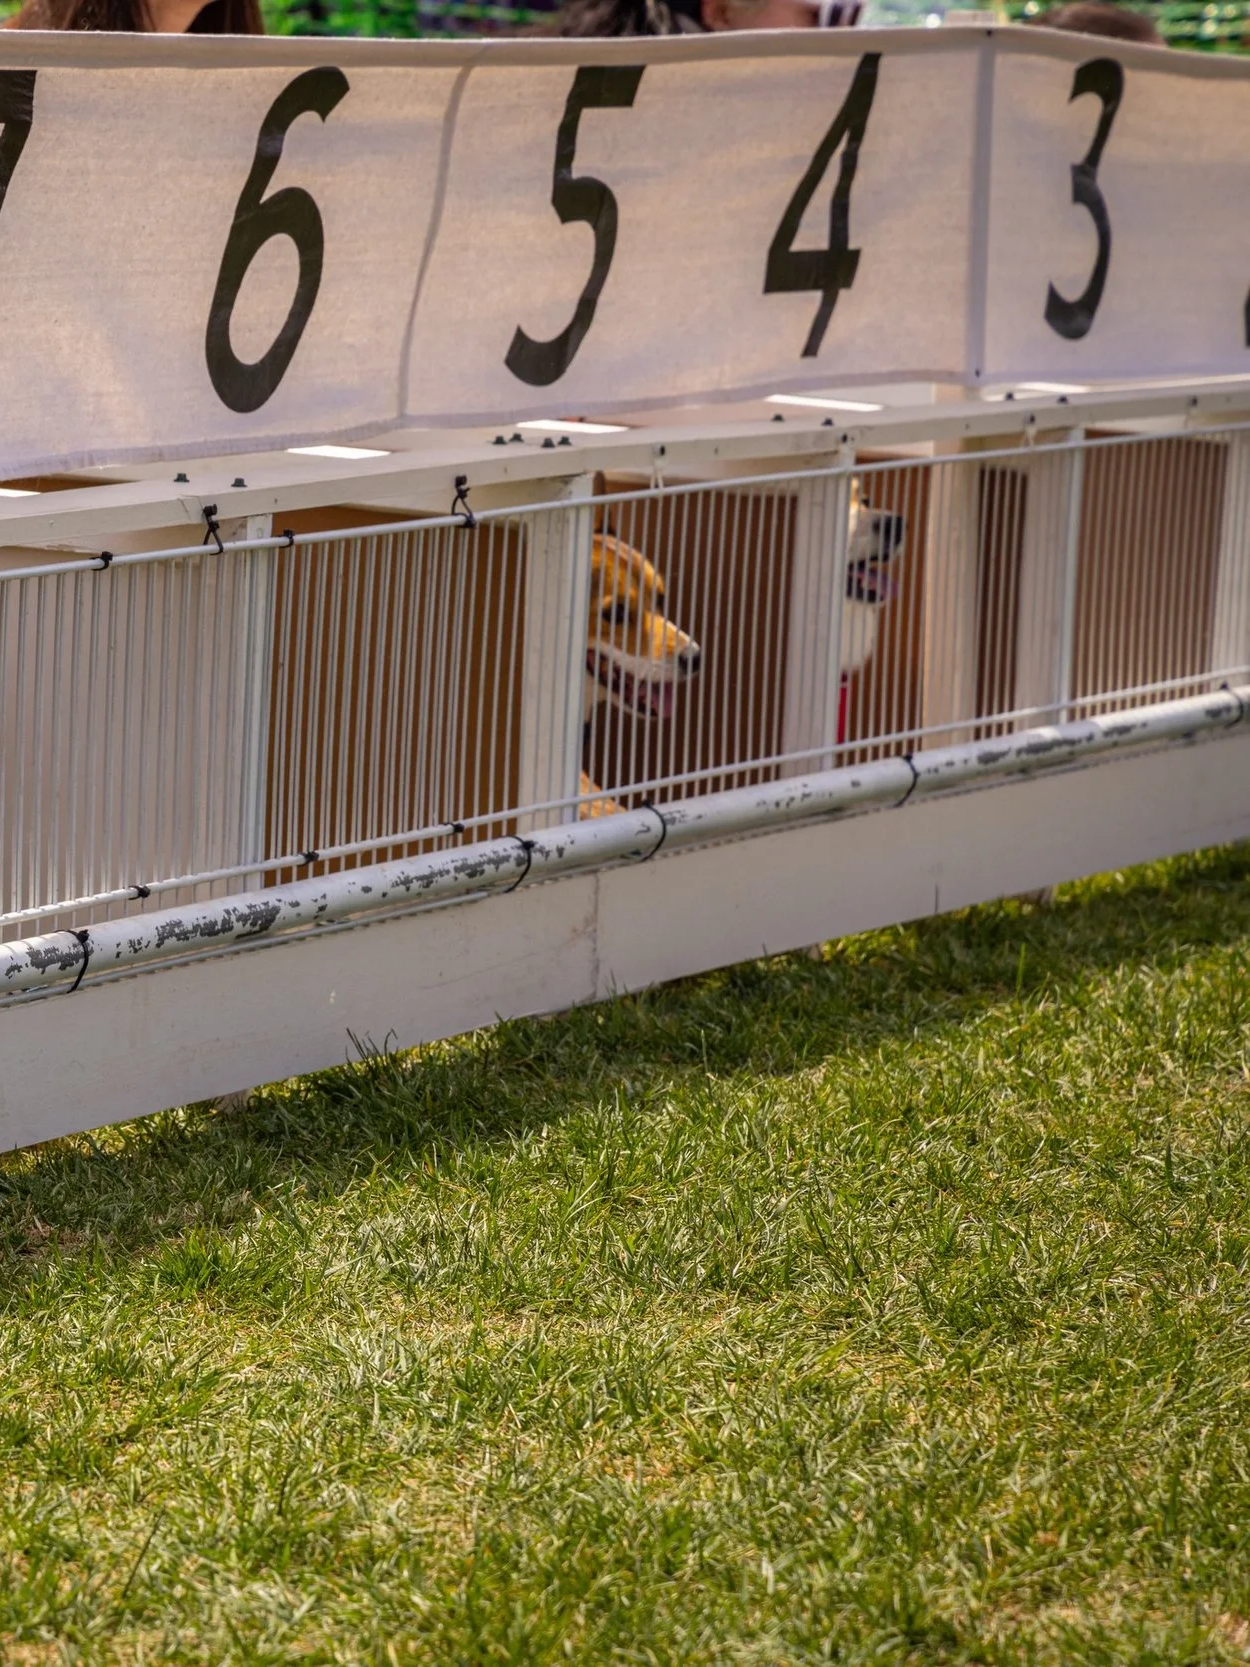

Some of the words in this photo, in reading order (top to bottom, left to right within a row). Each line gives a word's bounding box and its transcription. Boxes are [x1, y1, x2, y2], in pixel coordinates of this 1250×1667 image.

[205, 65, 351, 414] 6
[504, 63, 647, 387] 5
[762, 51, 883, 359] 4
[1043, 56, 1126, 341] 3
